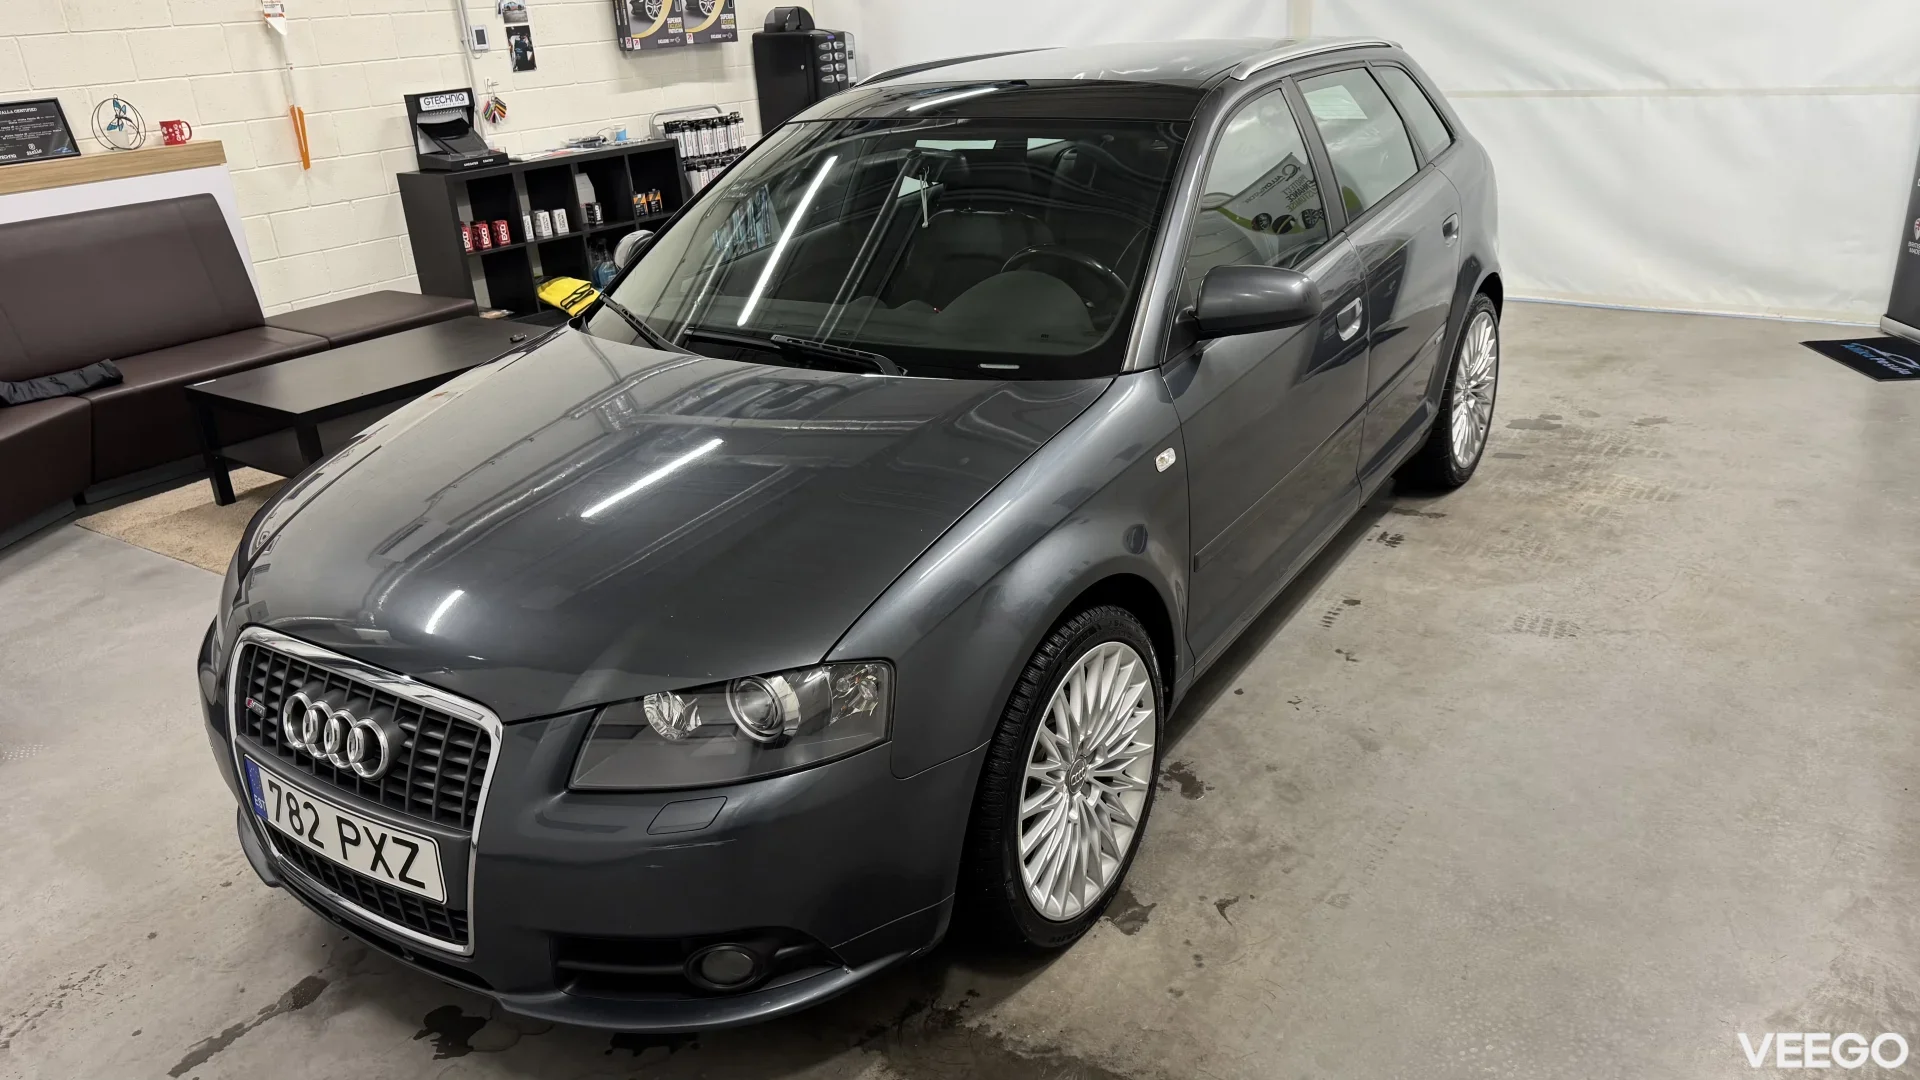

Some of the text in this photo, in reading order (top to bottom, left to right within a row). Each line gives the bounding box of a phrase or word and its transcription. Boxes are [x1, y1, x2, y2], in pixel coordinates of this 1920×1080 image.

[423, 93, 465, 106] GTECHNIQ
[254, 793, 266, 811] EST
[267, 779, 426, 889] 782 PXZ
